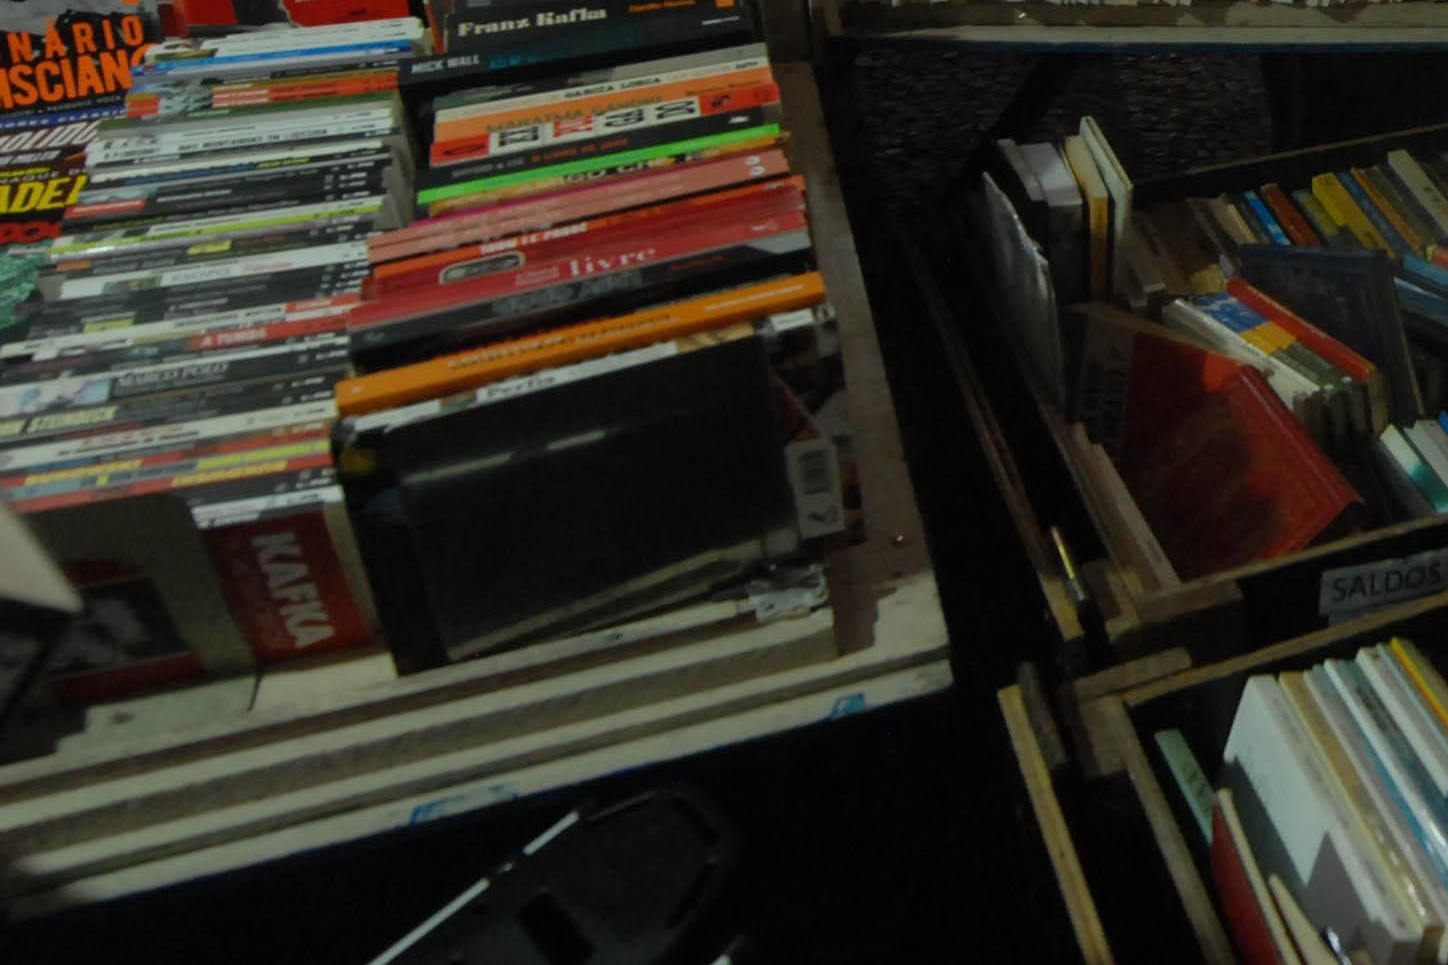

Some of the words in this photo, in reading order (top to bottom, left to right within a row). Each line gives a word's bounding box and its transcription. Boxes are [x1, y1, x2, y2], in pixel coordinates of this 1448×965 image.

[457, 17, 530, 37] Franz
[252, 531, 336, 648] KAFKA
[1332, 561, 1441, 602] SALDOS
